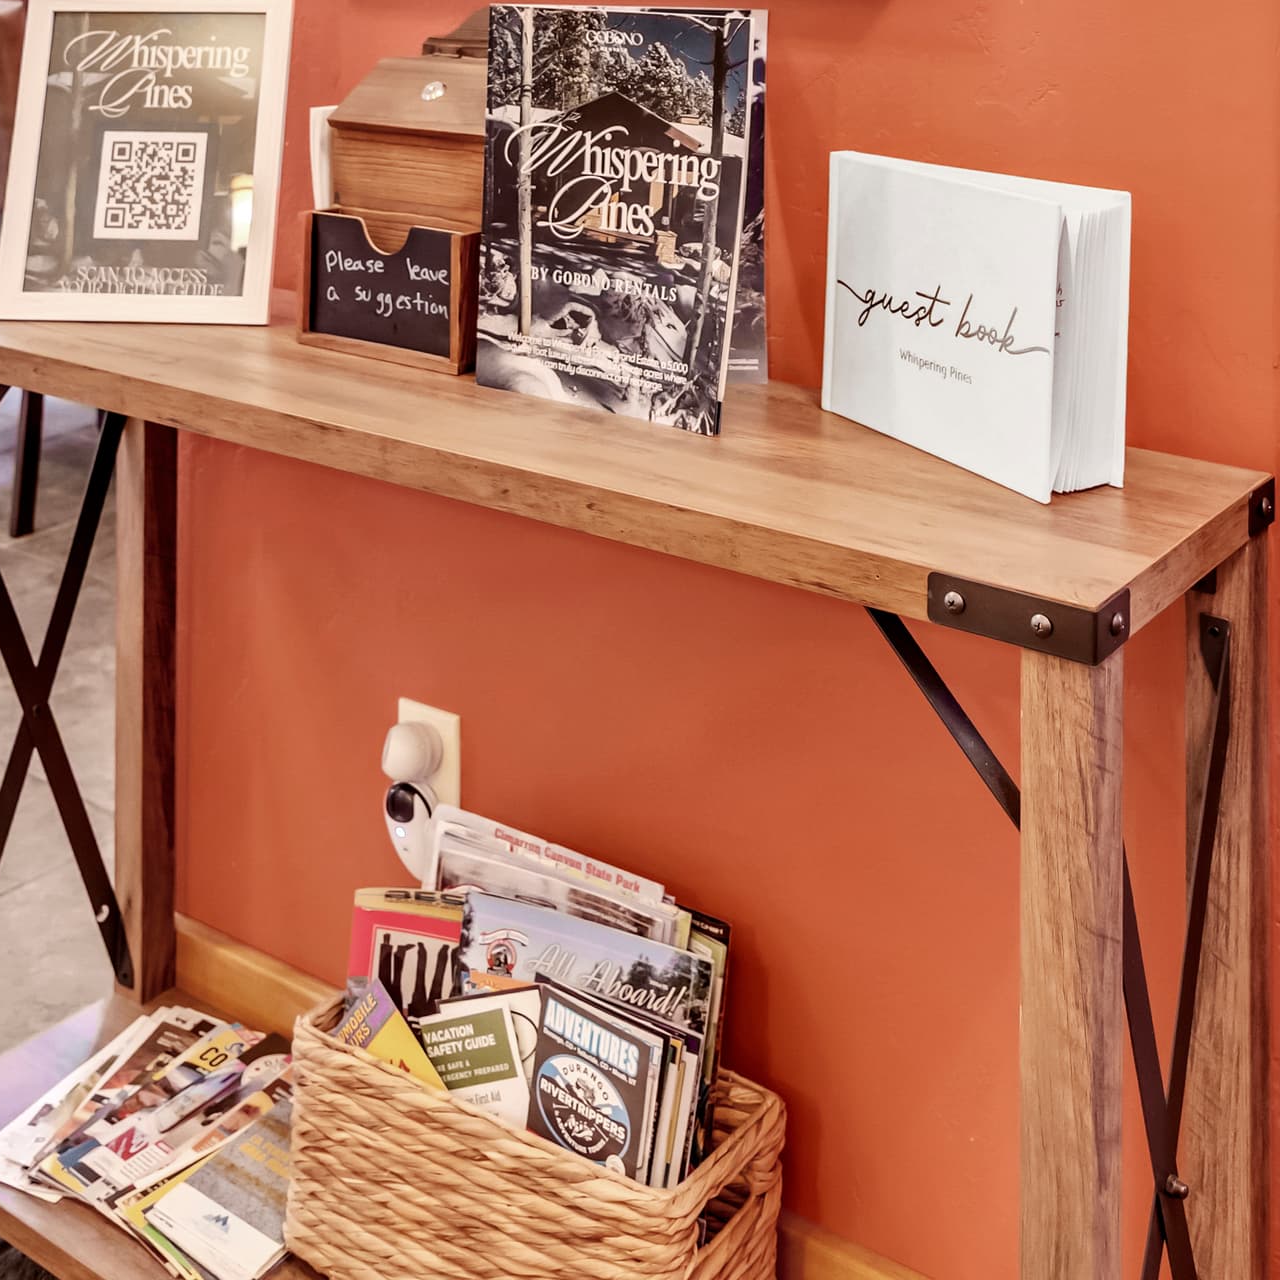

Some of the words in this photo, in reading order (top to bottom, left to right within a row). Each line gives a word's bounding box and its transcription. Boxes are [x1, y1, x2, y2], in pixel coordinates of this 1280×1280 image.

[63, 28, 251, 78] Whispering
[585, 29, 644, 47] GOBONO
[88, 68, 193, 119] Pines
[504, 122, 722, 201] Whispering
[536, 175, 656, 240] Pines
[76, 266, 120, 283] SCAN
[123, 266, 145, 284] TO
[148, 267, 209, 285] ACCESS
[325, 249, 385, 273] Please
[405, 256, 450, 286] leave
[531, 268, 548, 282] BY
[553, 269, 610, 291] GOBONO
[613, 281, 678, 302] RENTALS
[172, 281, 225, 297] GUIDE
[326, 285, 341, 301] a
[354, 285, 449, 320] suggestion
[836, 279, 951, 328] guest
[955, 293, 1051, 356] book
[558, 361, 576, 376] truly
[898, 347, 948, 380] Whispering
[949, 366, 973, 385] Pines
[494, 827, 541, 856] Cimarron
[585, 861, 613, 883] State
[615, 873, 641, 894] Park
[527, 944, 577, 978] All
[580, 958, 688, 1018] Aboard!
[424, 1023, 475, 1045] VACATION
[427, 1039, 464, 1058] SAFETY
[465, 1033, 497, 1051] GUIDE
[543, 996, 641, 1078] ADVENTURES
[473, 1063, 510, 1076] PREPARED
[562, 1062, 610, 1102] DURANGO
[540, 1077, 627, 1141] RIVERTRIPPERS
